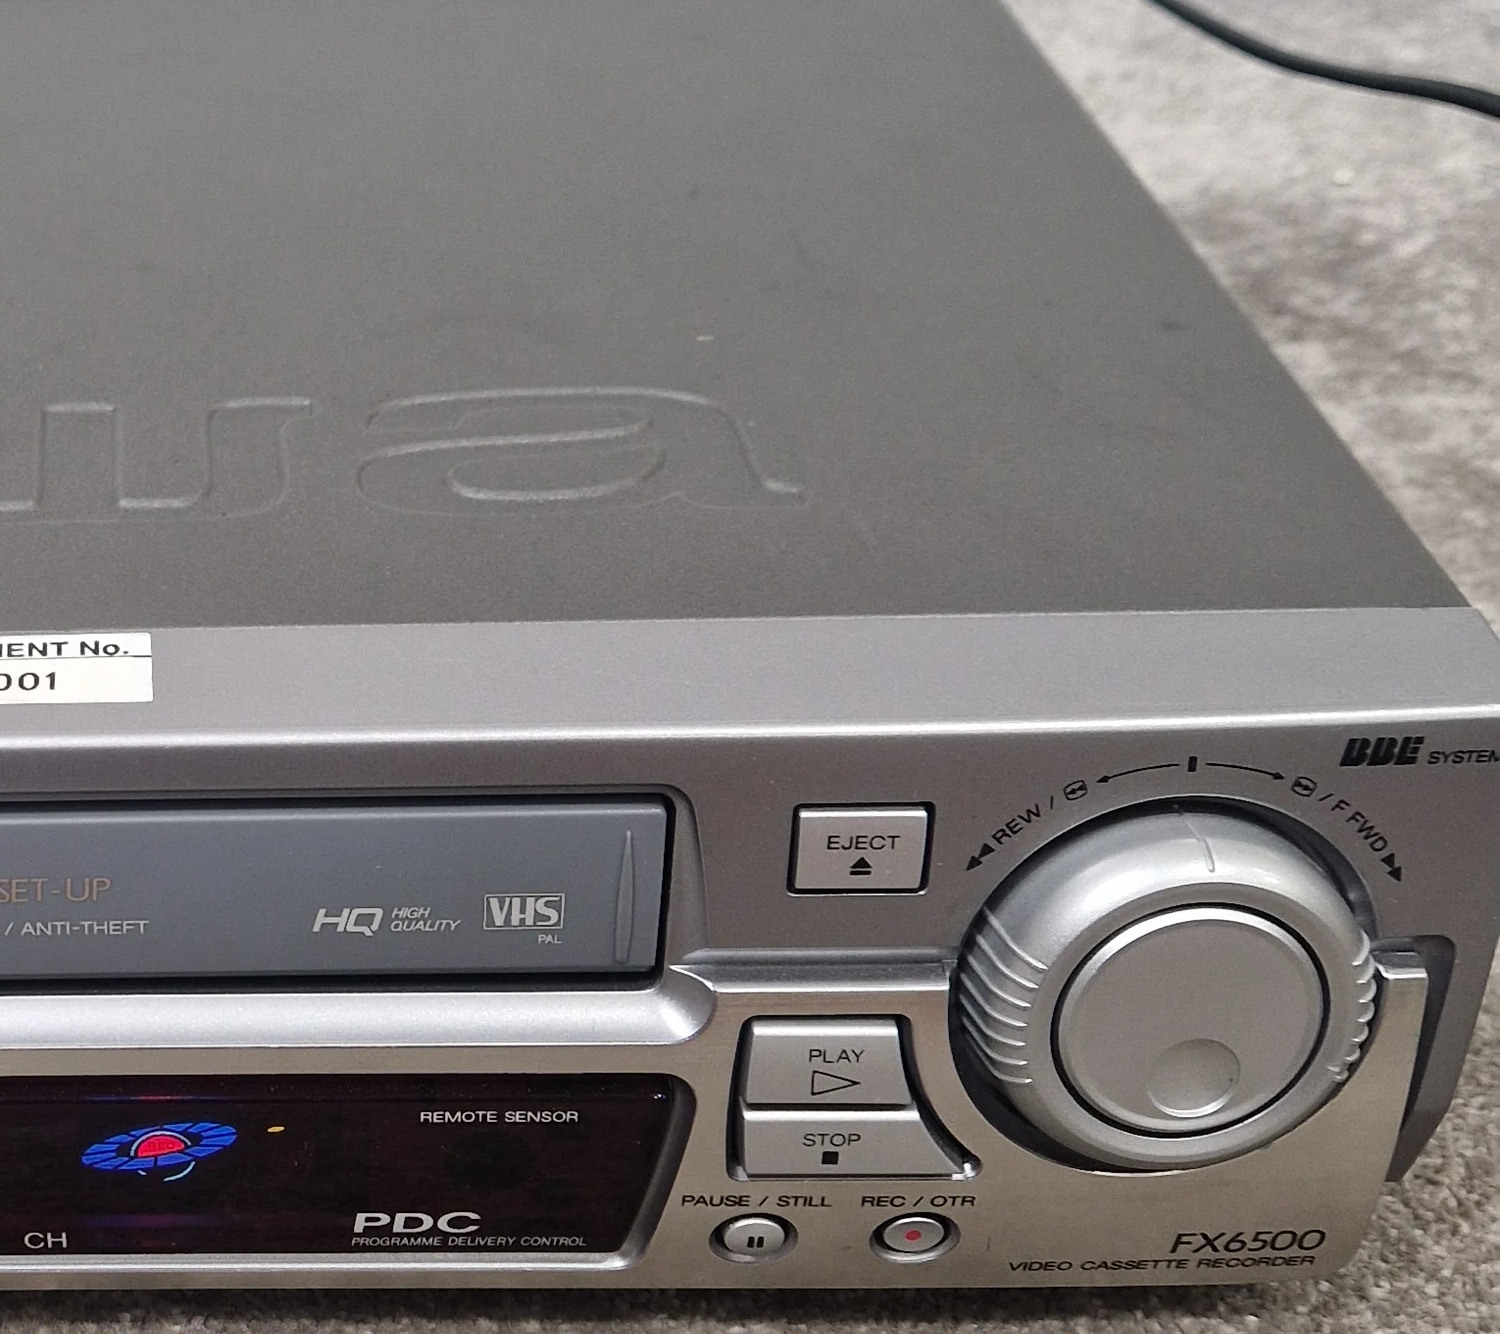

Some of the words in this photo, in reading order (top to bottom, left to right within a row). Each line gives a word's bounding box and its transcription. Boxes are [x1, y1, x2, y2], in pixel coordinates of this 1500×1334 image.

[79, 640, 130, 656] No.
[1339, 736, 1425, 767] BBE
[991, 803, 1042, 845] REW
[1345, 811, 1388, 852] FWD
[826, 834, 902, 851] EJECT
[391, 907, 432, 919] HIGH
[488, 896, 561, 927] VHS
[19, 919, 151, 937] ANTI-THEFT
[312, 907, 385, 937] HQ
[390, 919, 462, 933] QUALITY
[537, 934, 563, 945] PAL
[808, 1048, 865, 1064] PLAY
[419, 1111, 498, 1124] REMOTE
[504, 1111, 579, 1124] SENSOR
[802, 1132, 861, 1147] STOP
[680, 1195, 751, 1208] PAUSE
[776, 1195, 832, 1208] STILL
[860, 1195, 907, 1208] REC
[929, 1194, 977, 1208] OTR
[353, 1212, 482, 1234] PDC
[23, 1231, 68, 1250] CH
[351, 1237, 442, 1247] PROGRAMME
[448, 1237, 517, 1247] DELIVERY
[520, 1236, 587, 1247] CONTROL
[1169, 1229, 1327, 1254] FX6500
[1009, 1261, 1073, 1272] VIDEO
[1080, 1258, 1190, 1271] CASSETTE
[1197, 1255, 1316, 1269] RECORDER
